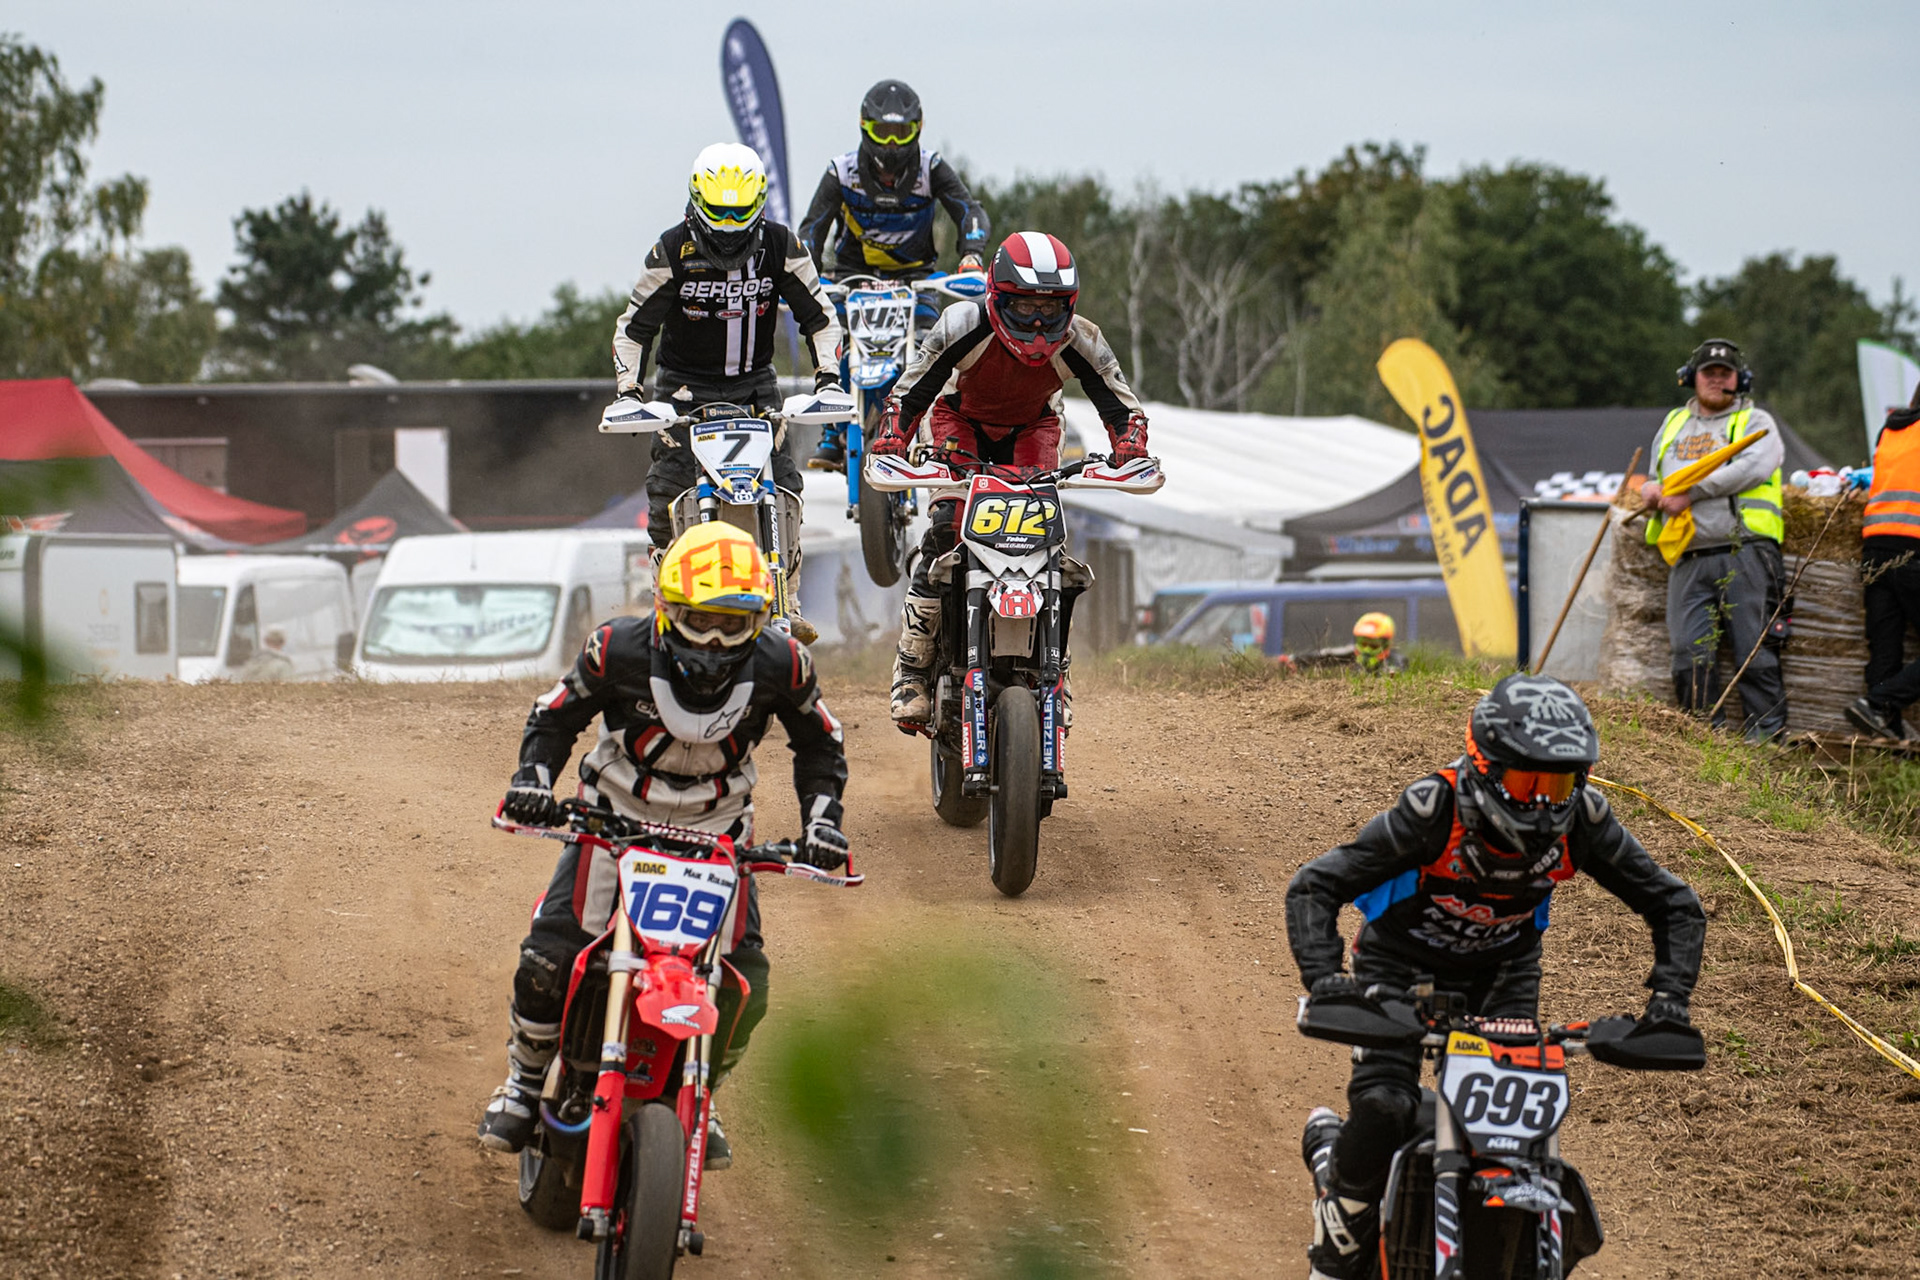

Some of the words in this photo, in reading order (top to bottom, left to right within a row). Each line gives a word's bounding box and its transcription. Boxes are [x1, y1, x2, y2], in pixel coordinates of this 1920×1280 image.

[680, 277, 774, 298] BERGOS
[720, 433, 752, 464] 7
[971, 498, 1056, 536] 612
[1043, 693, 1053, 770] METZELER
[633, 862, 666, 875] ADAC
[628, 881, 727, 941] 169
[1454, 1041, 1484, 1052] ADAC
[1453, 1071, 1561, 1131] 693
[1487, 1137, 1520, 1151] KTM
[686, 1127, 702, 1215] METZELER
